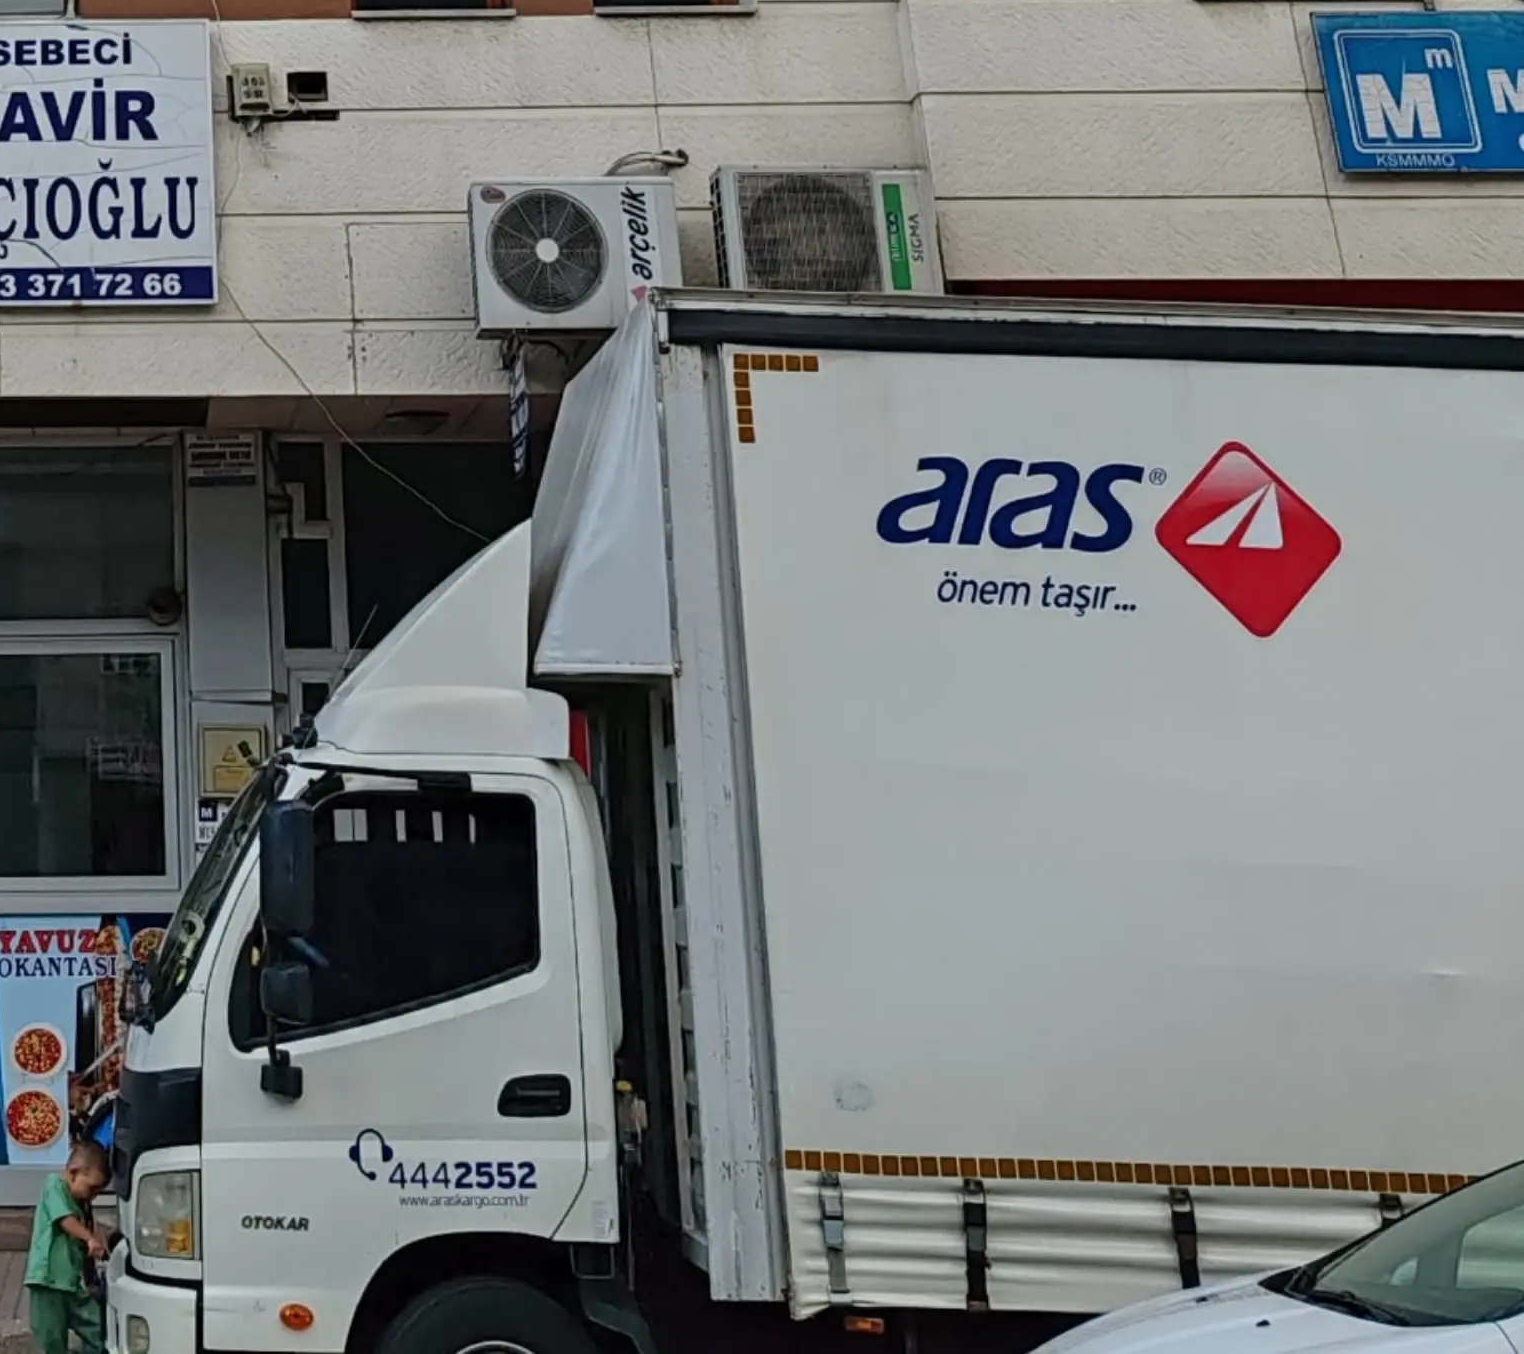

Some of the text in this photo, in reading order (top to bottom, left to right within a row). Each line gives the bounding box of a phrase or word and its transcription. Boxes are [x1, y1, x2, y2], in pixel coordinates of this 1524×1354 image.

[620, 186, 653, 281] arçelik
[908, 213, 924, 264] SIGMA
[28, 273, 81, 298] 371
[94, 273, 133, 297] 72
[143, 272, 182, 296] 66
[876, 455, 1144, 552] aras
[938, 571, 1137, 617] önem taşır...
[388, 1161, 537, 1190] 4442552
[399, 1193, 529, 1209] www.araskargo.com.tr
[241, 1215, 309, 1231] OTOKAR
